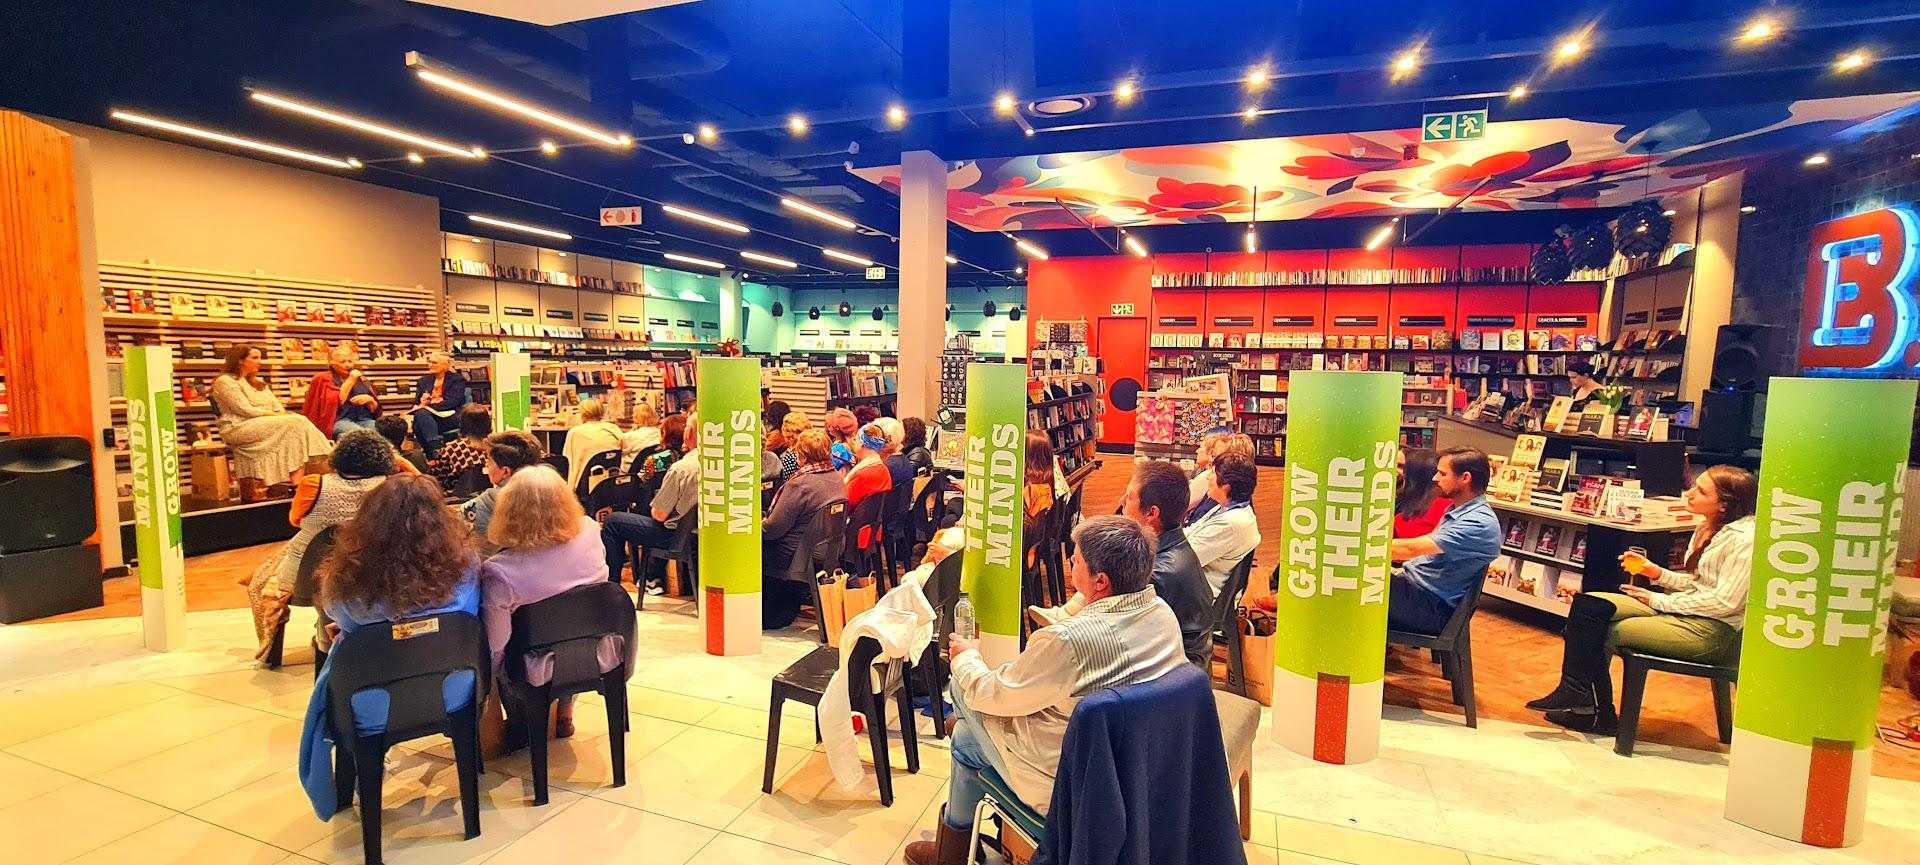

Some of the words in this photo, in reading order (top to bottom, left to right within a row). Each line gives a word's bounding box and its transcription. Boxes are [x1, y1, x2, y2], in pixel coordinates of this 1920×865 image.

[129, 399, 151, 529] MINDS
[161, 428, 179, 516] GROW
[703, 421, 725, 527] THEIR
[727, 409, 757, 535] MINDS
[966, 435, 986, 553] THEIR
[985, 423, 1020, 569] MINDS
[1287, 462, 1319, 599] GROW
[1321, 455, 1367, 597] THEIR
[1360, 439, 1397, 606] MINDS
[1762, 487, 1823, 650] GROW
[1822, 481, 1887, 647] THEIR
